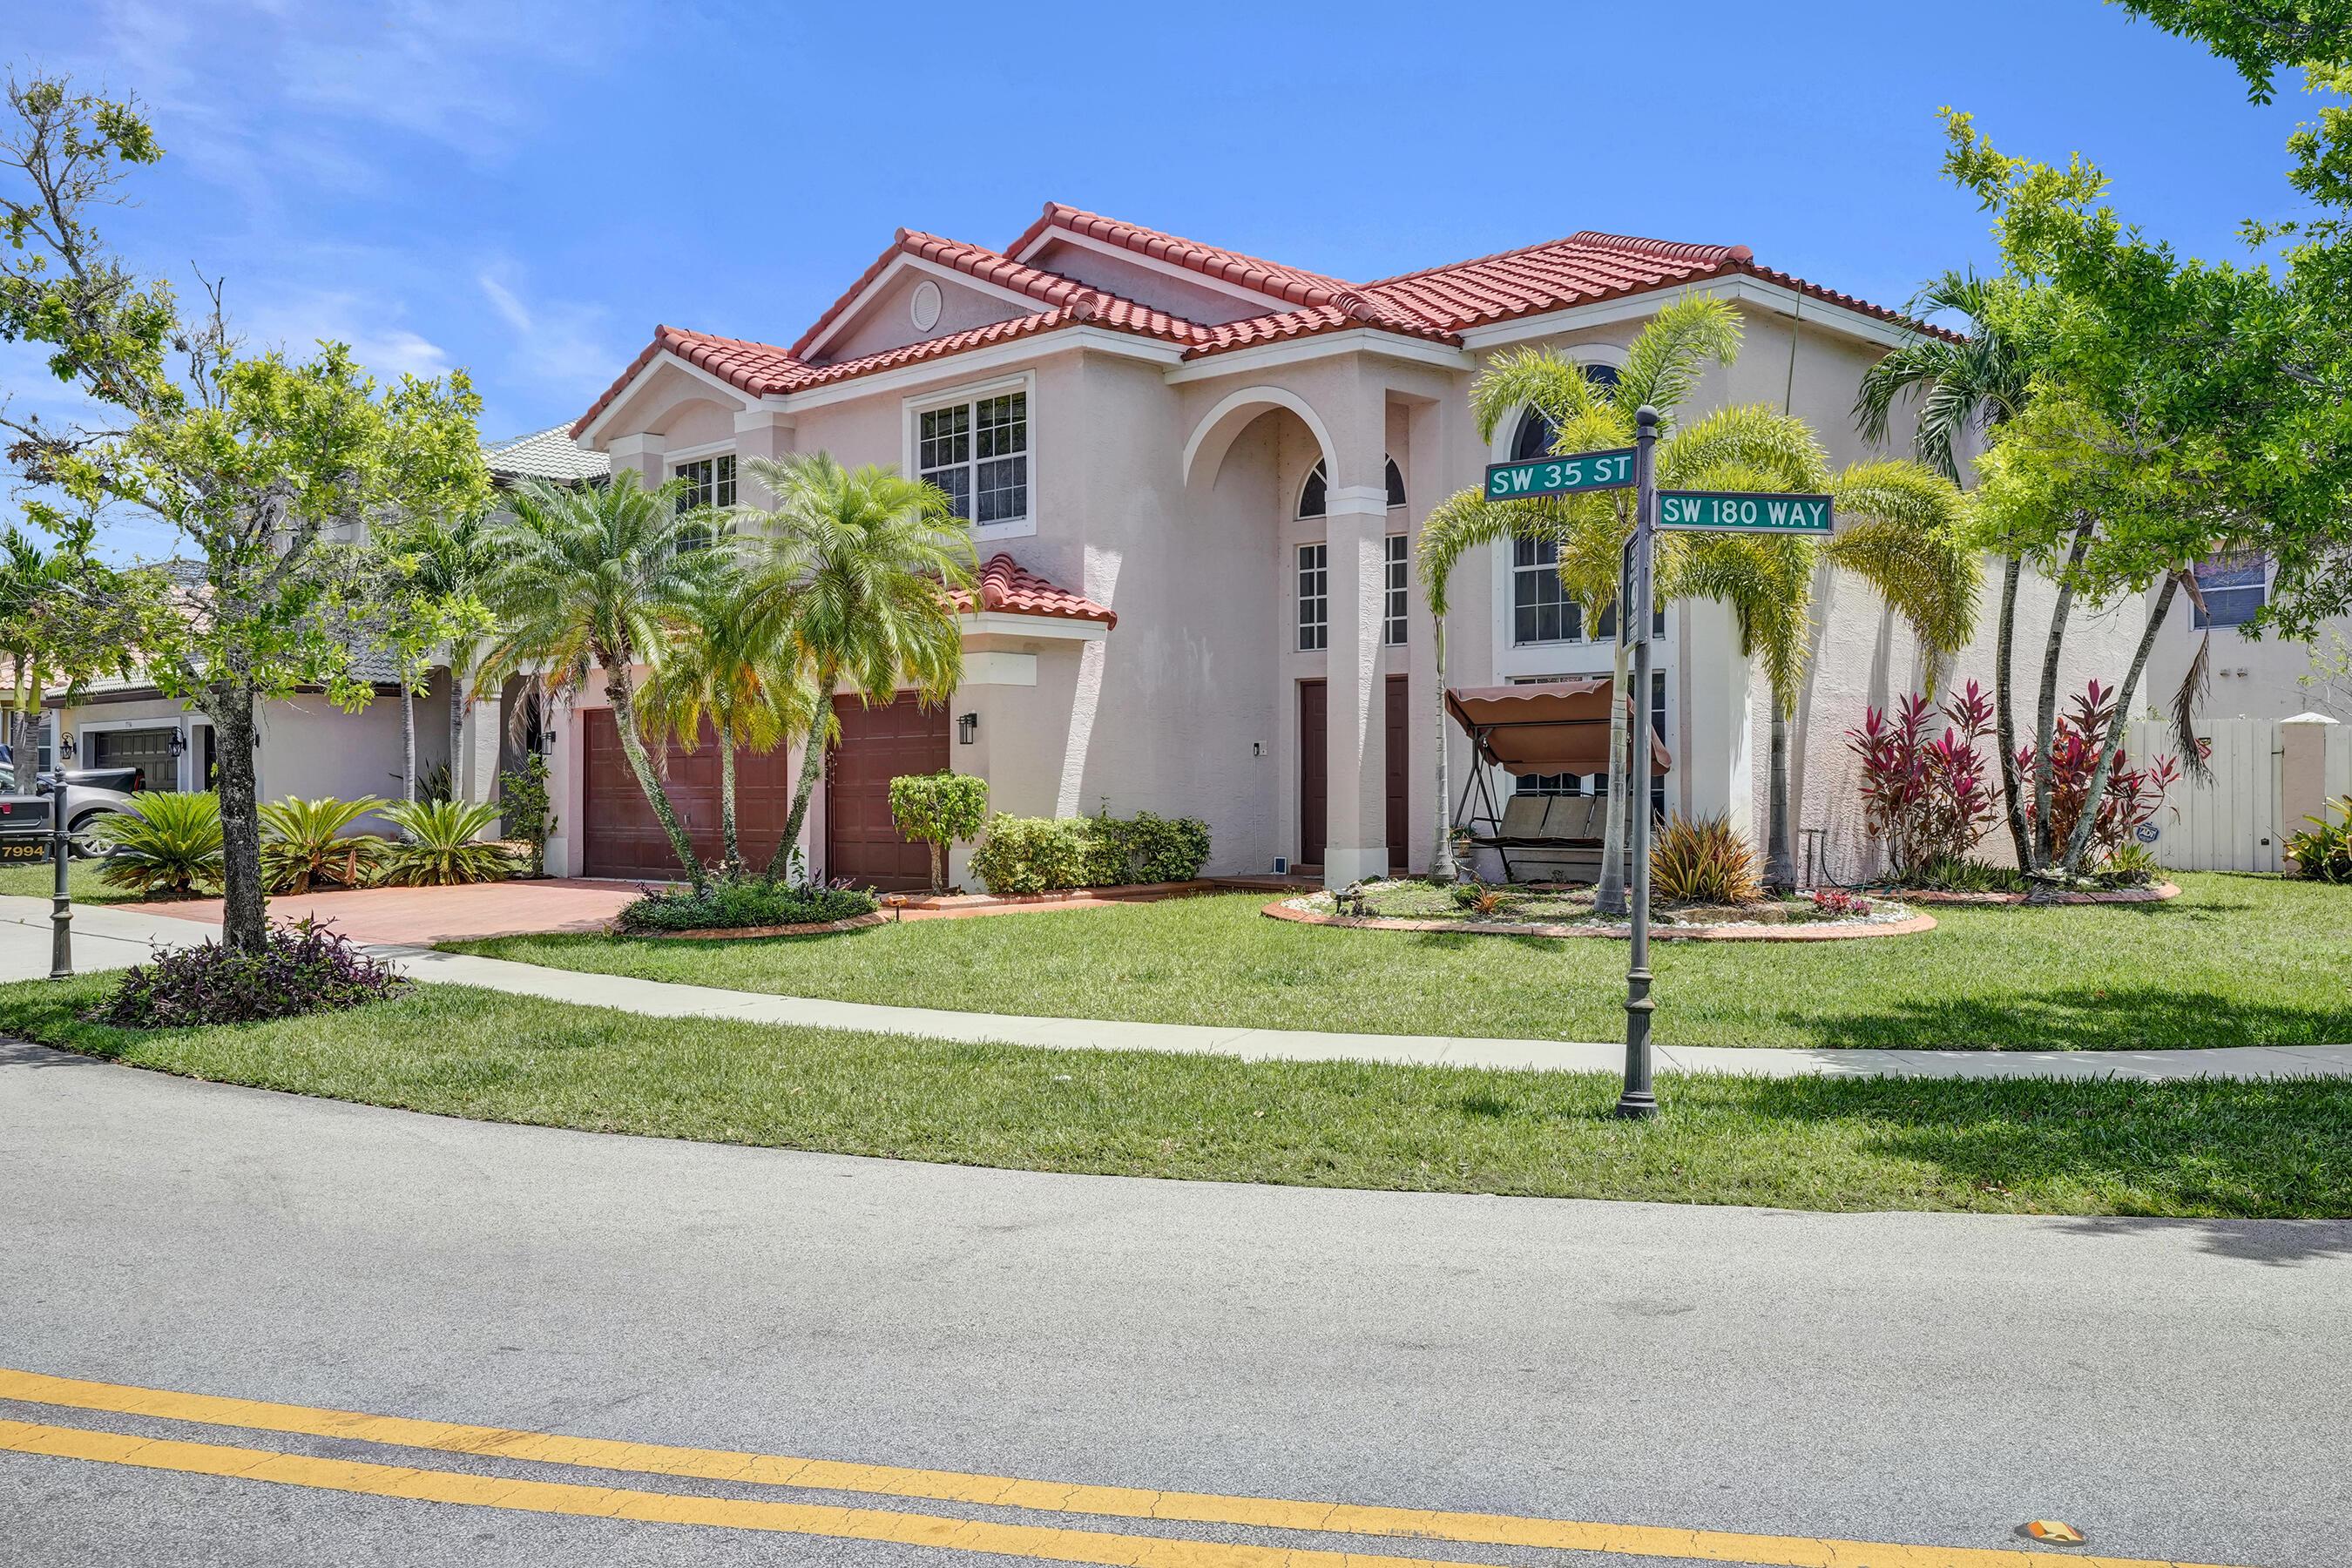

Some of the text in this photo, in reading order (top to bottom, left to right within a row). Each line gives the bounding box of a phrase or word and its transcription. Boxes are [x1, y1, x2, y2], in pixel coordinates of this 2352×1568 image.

[1491, 456, 1632, 494] SW 35 ST
[1663, 498, 1825, 526] SW 180 WAY
[2139, 827, 2158, 838] ADT
[2, 845, 44, 857] 7994
